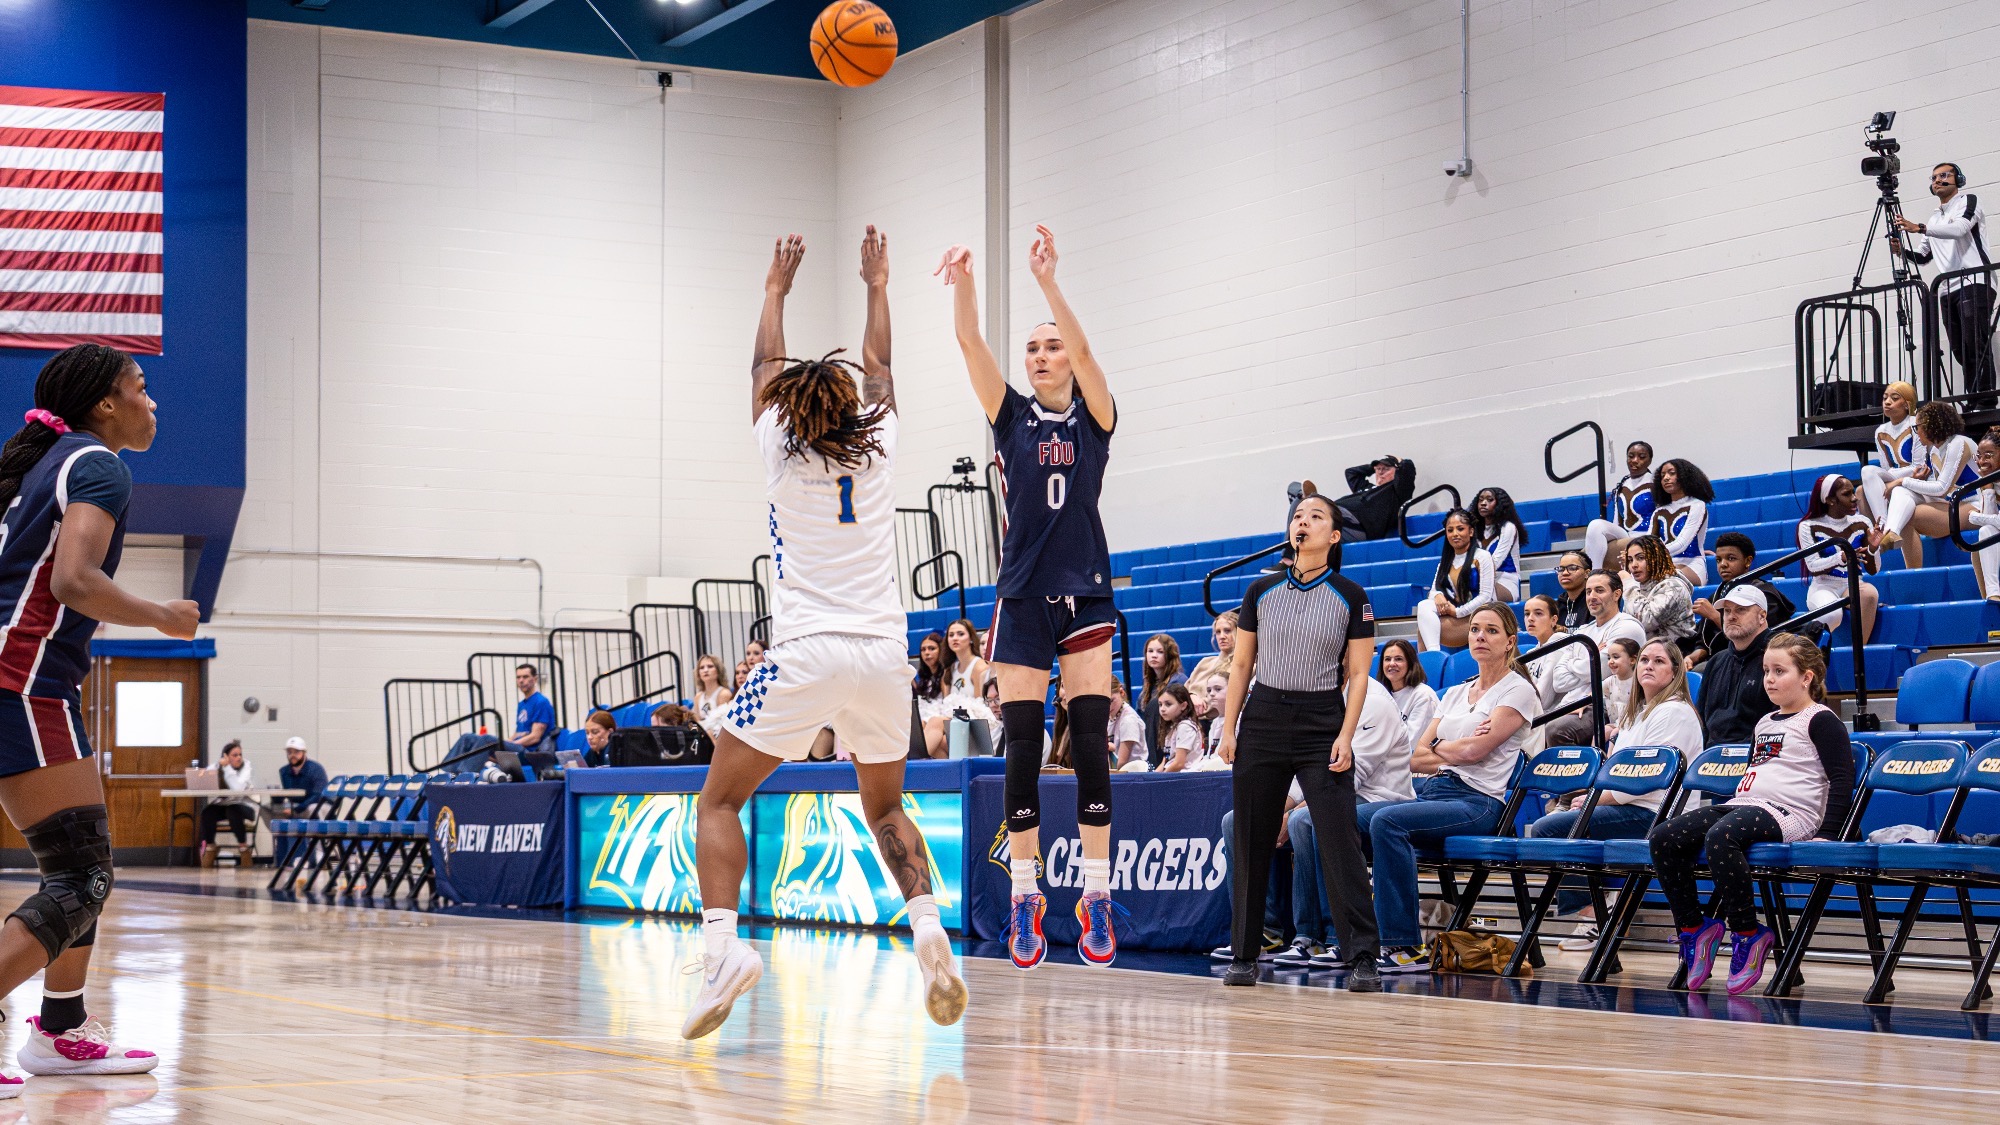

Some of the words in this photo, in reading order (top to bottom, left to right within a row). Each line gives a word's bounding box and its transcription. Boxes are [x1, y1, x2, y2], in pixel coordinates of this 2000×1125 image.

[1038, 441, 1075, 465] FDU
[836, 474, 858, 525] 1
[1047, 473, 1066, 509] 0
[1757, 735, 1784, 744] ATLANTA
[1533, 763, 1589, 777] CHARGERS
[1609, 763, 1667, 777] CHARGERS
[1698, 763, 1748, 776] CHARGE
[1882, 758, 1955, 775] CHARGERS
[456, 824, 490, 852] NEW
[491, 823, 545, 853] HAVEN
[1046, 837, 1227, 890] CHRGERS
